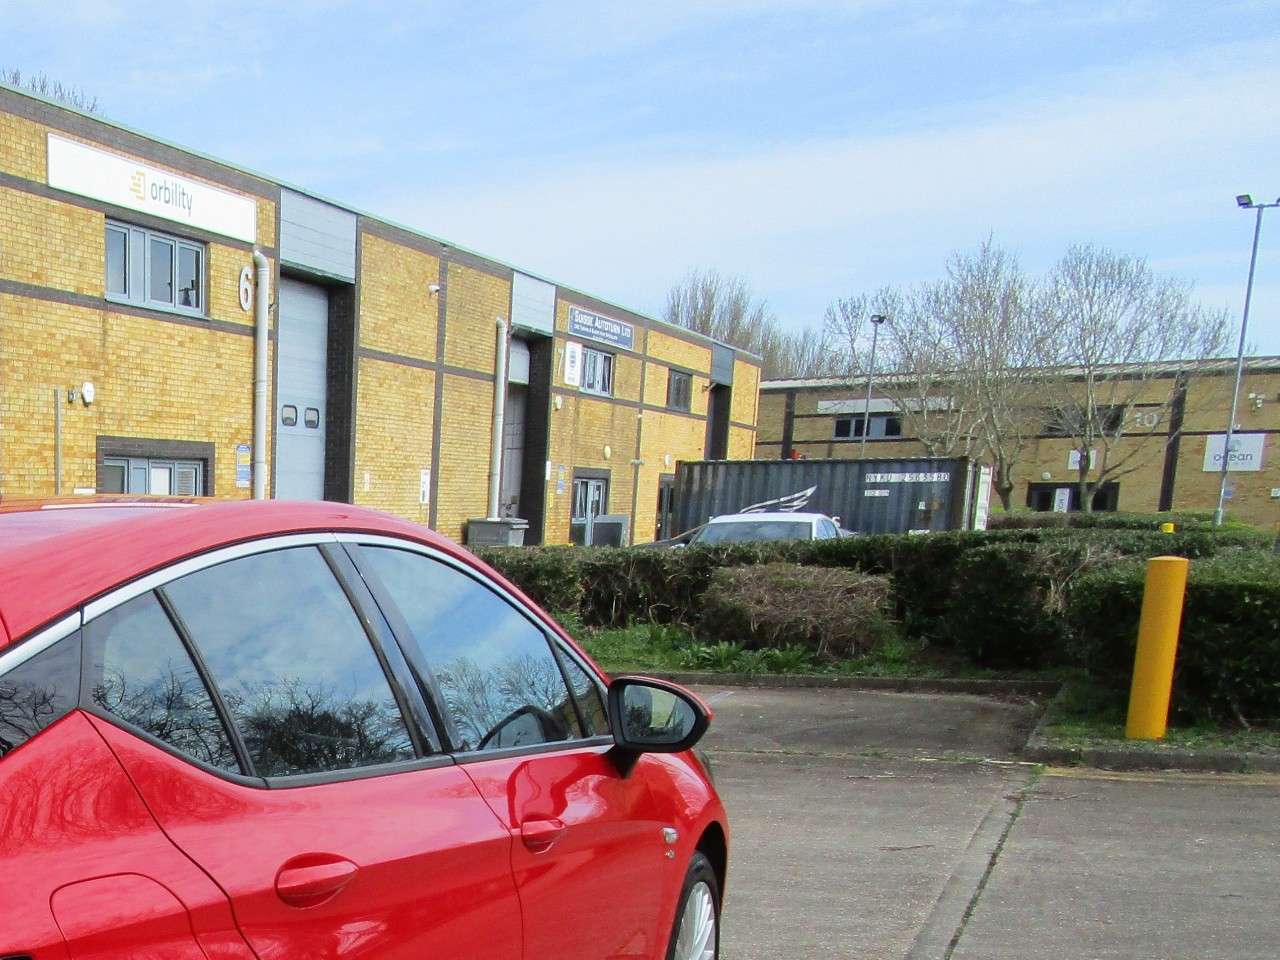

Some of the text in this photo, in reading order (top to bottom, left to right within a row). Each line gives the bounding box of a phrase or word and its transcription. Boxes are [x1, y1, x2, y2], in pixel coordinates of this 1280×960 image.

[150, 180, 193, 217] orbility
[239, 266, 254, 311] 6
[1213, 453, 1253, 462] oean
